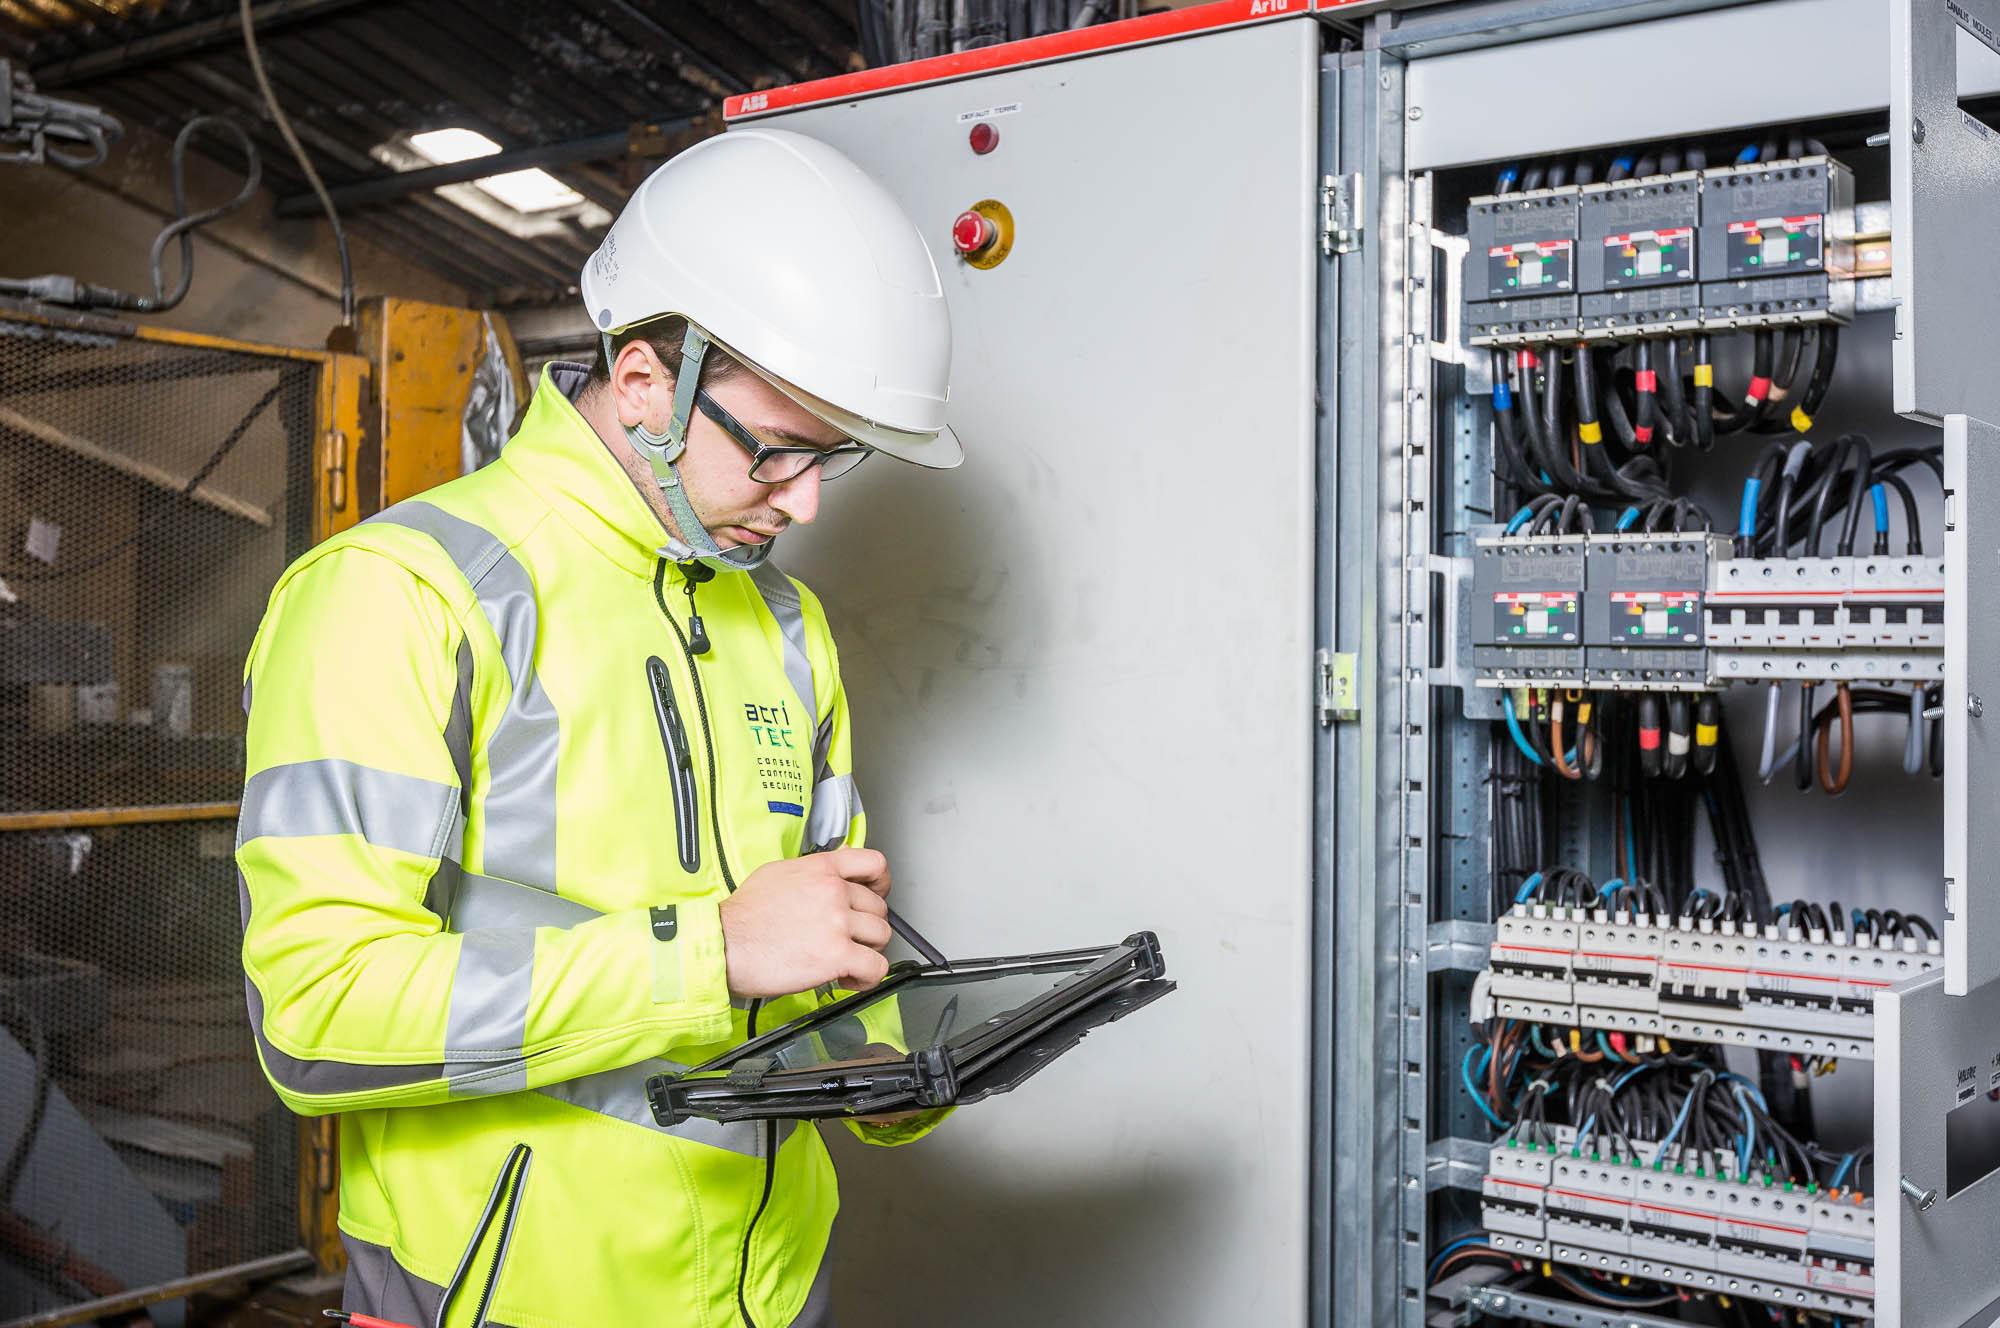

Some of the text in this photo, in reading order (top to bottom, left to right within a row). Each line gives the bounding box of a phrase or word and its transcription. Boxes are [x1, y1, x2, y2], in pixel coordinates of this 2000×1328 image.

[740, 94, 768, 112] ABB
[744, 700, 790, 725] acri
[750, 725, 794, 748] TEC
